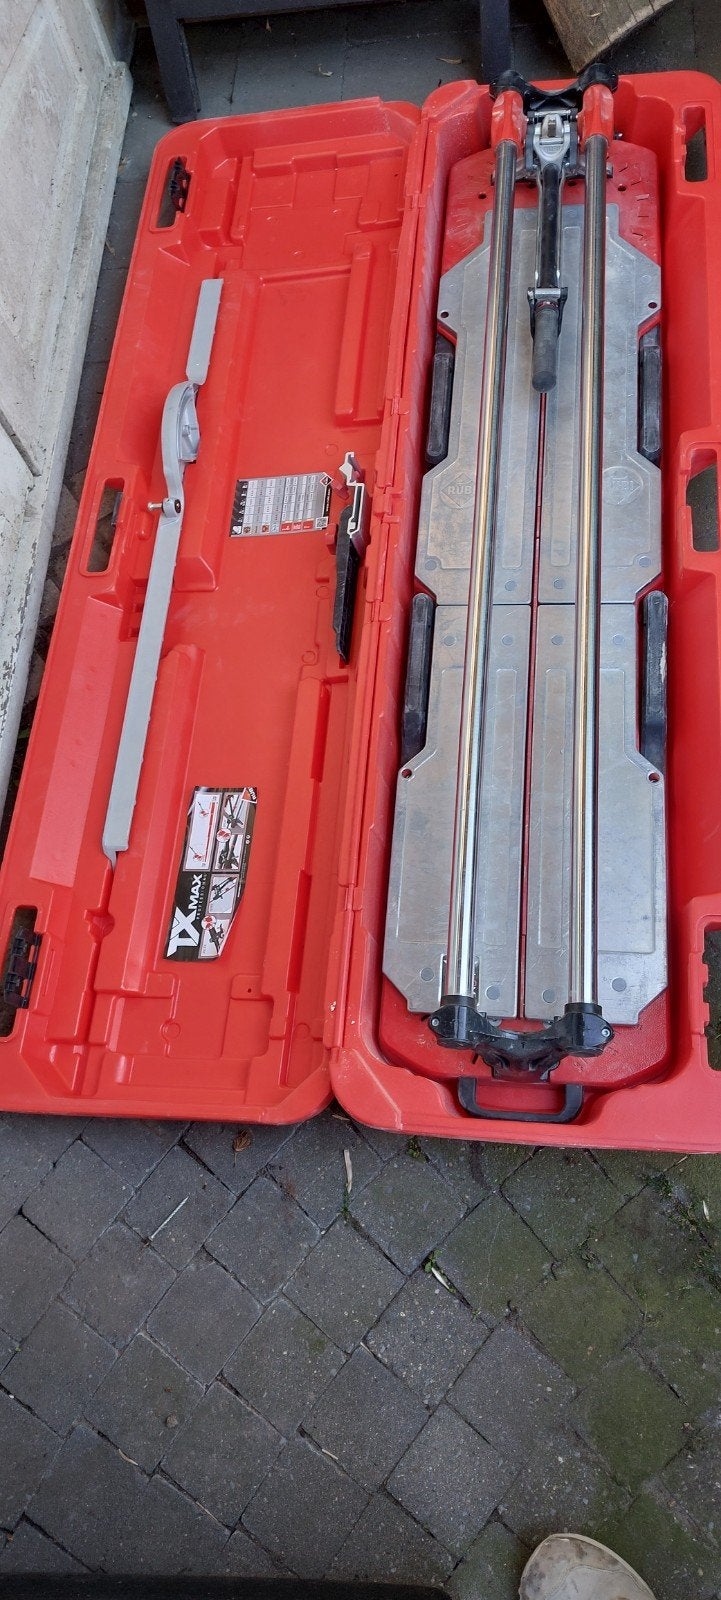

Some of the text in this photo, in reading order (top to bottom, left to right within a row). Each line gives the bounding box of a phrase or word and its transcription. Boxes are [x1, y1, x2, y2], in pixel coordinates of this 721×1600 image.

[448, 484, 473, 495] RUB
[166, 906, 200, 957] TX
[188, 874, 203, 910] MAX
